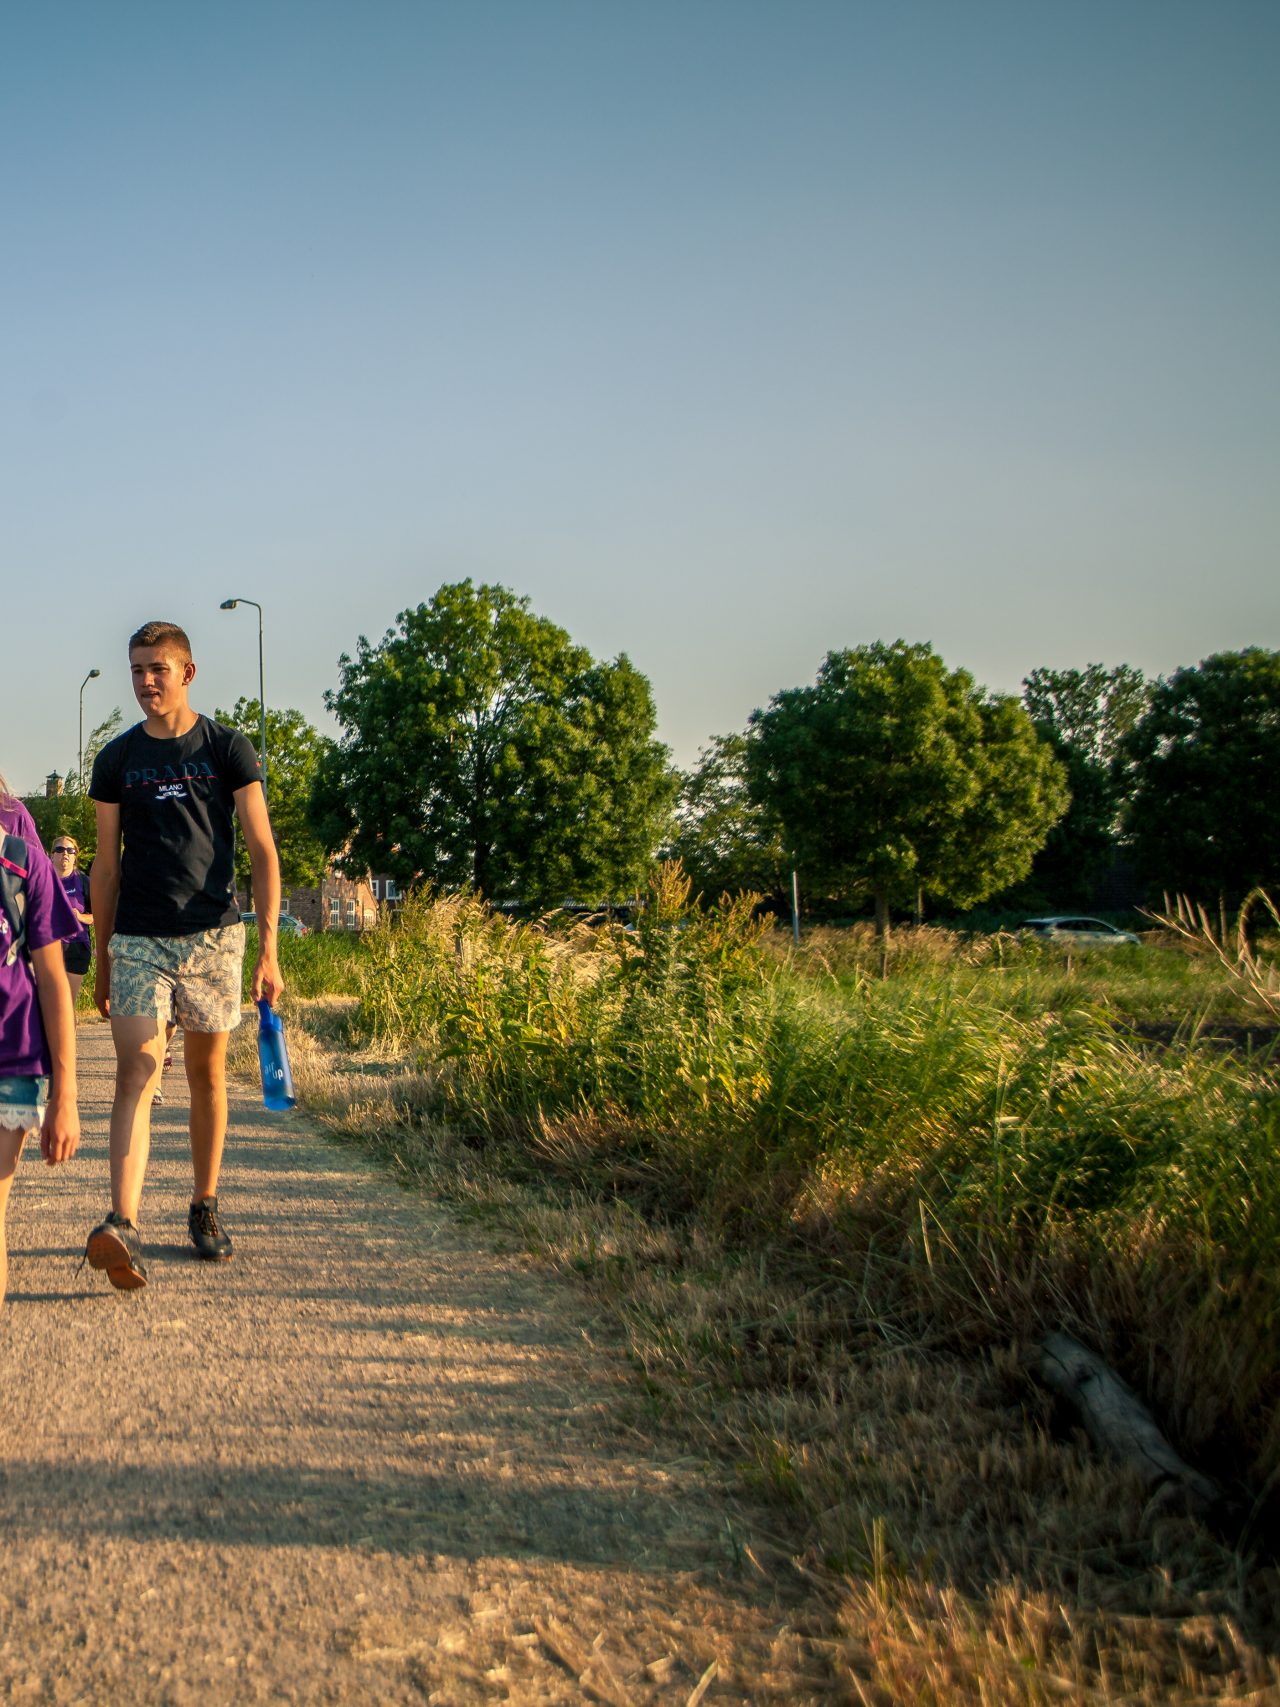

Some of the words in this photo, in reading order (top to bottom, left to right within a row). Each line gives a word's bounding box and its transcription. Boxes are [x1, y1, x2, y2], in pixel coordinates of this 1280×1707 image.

[126, 762, 217, 788] PRADA
[159, 783, 183, 792] MILANO
[272, 1069, 283, 1081] up
